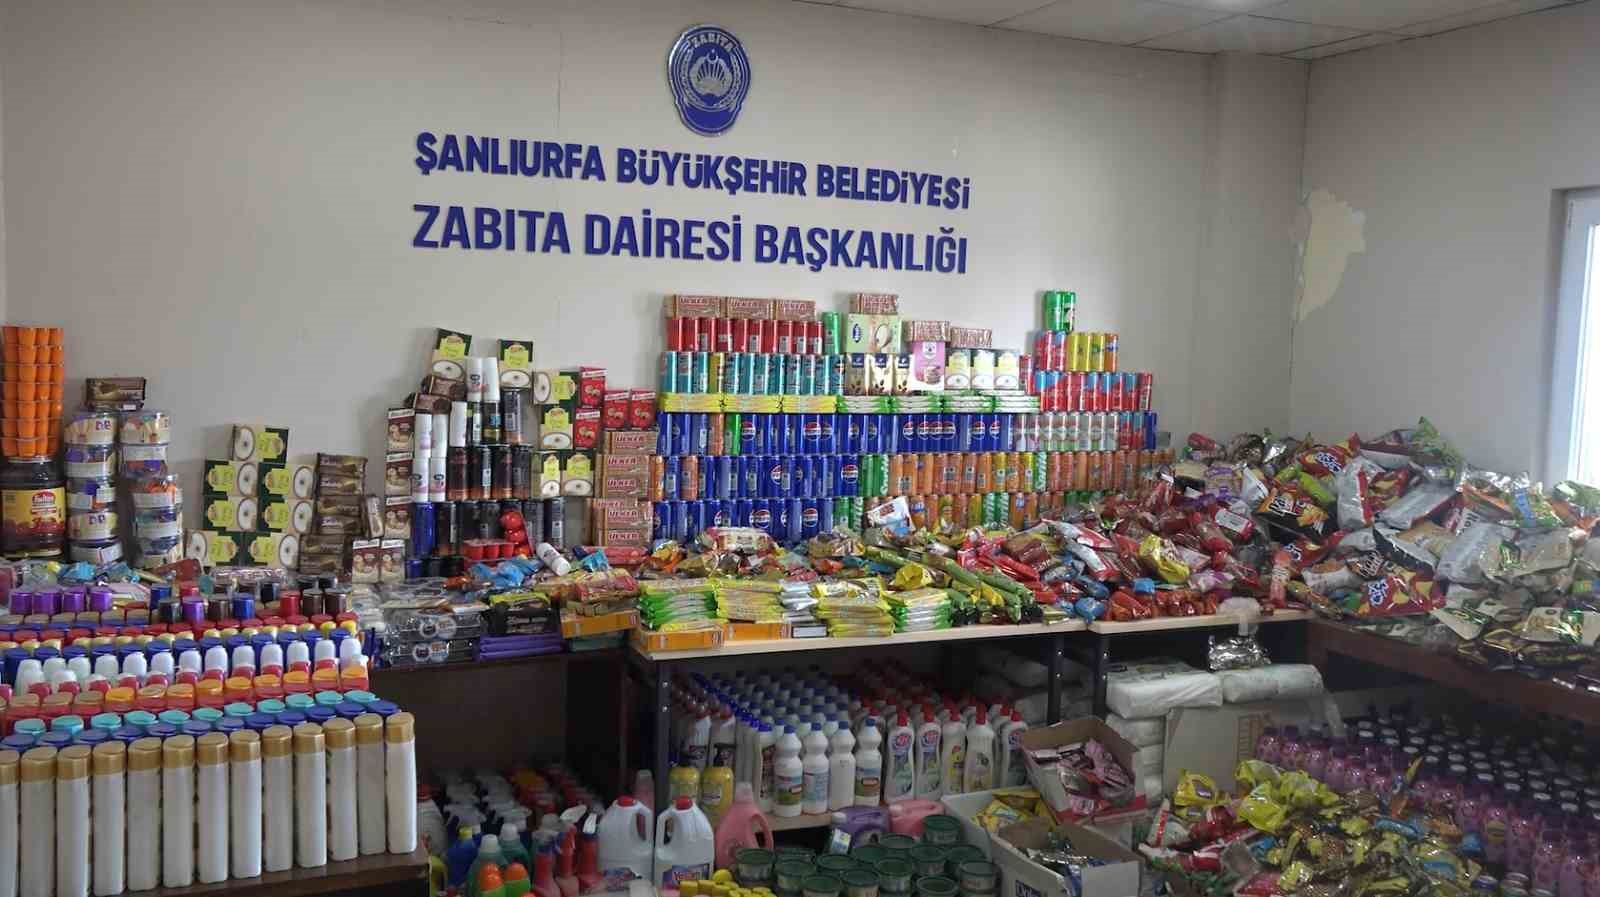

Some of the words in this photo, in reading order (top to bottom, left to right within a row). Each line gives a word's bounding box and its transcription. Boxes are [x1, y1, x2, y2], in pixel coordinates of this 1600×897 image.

[414, 132, 606, 181] ŞANLIURFA
[413, 204, 570, 254] ZABITA
[585, 209, 742, 262] DAİRESİ
[755, 224, 967, 273] BAŞKANLIĞI
